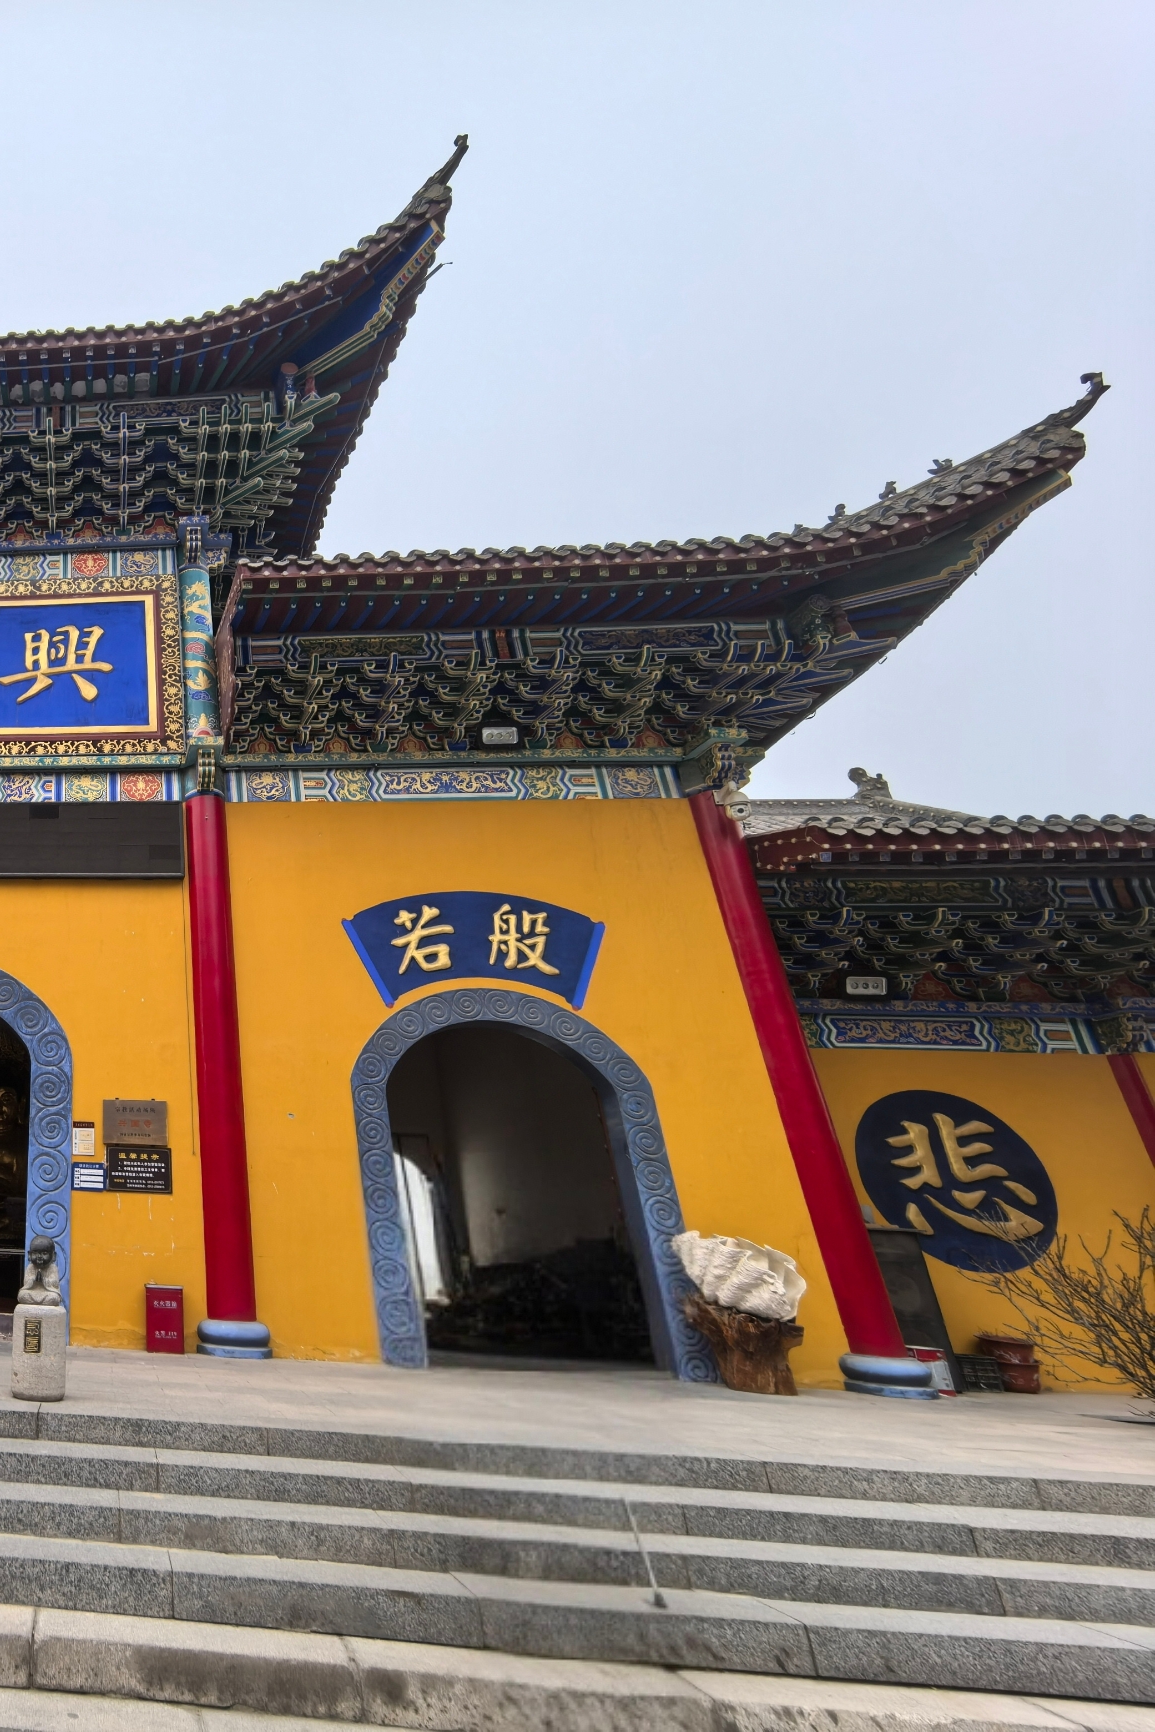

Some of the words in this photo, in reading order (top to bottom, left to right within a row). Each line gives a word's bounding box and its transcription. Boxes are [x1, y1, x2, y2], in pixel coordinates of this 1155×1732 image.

[118, 1152, 160, 1160] 温馨提示
[884, 1112, 1045, 1241] 悲
